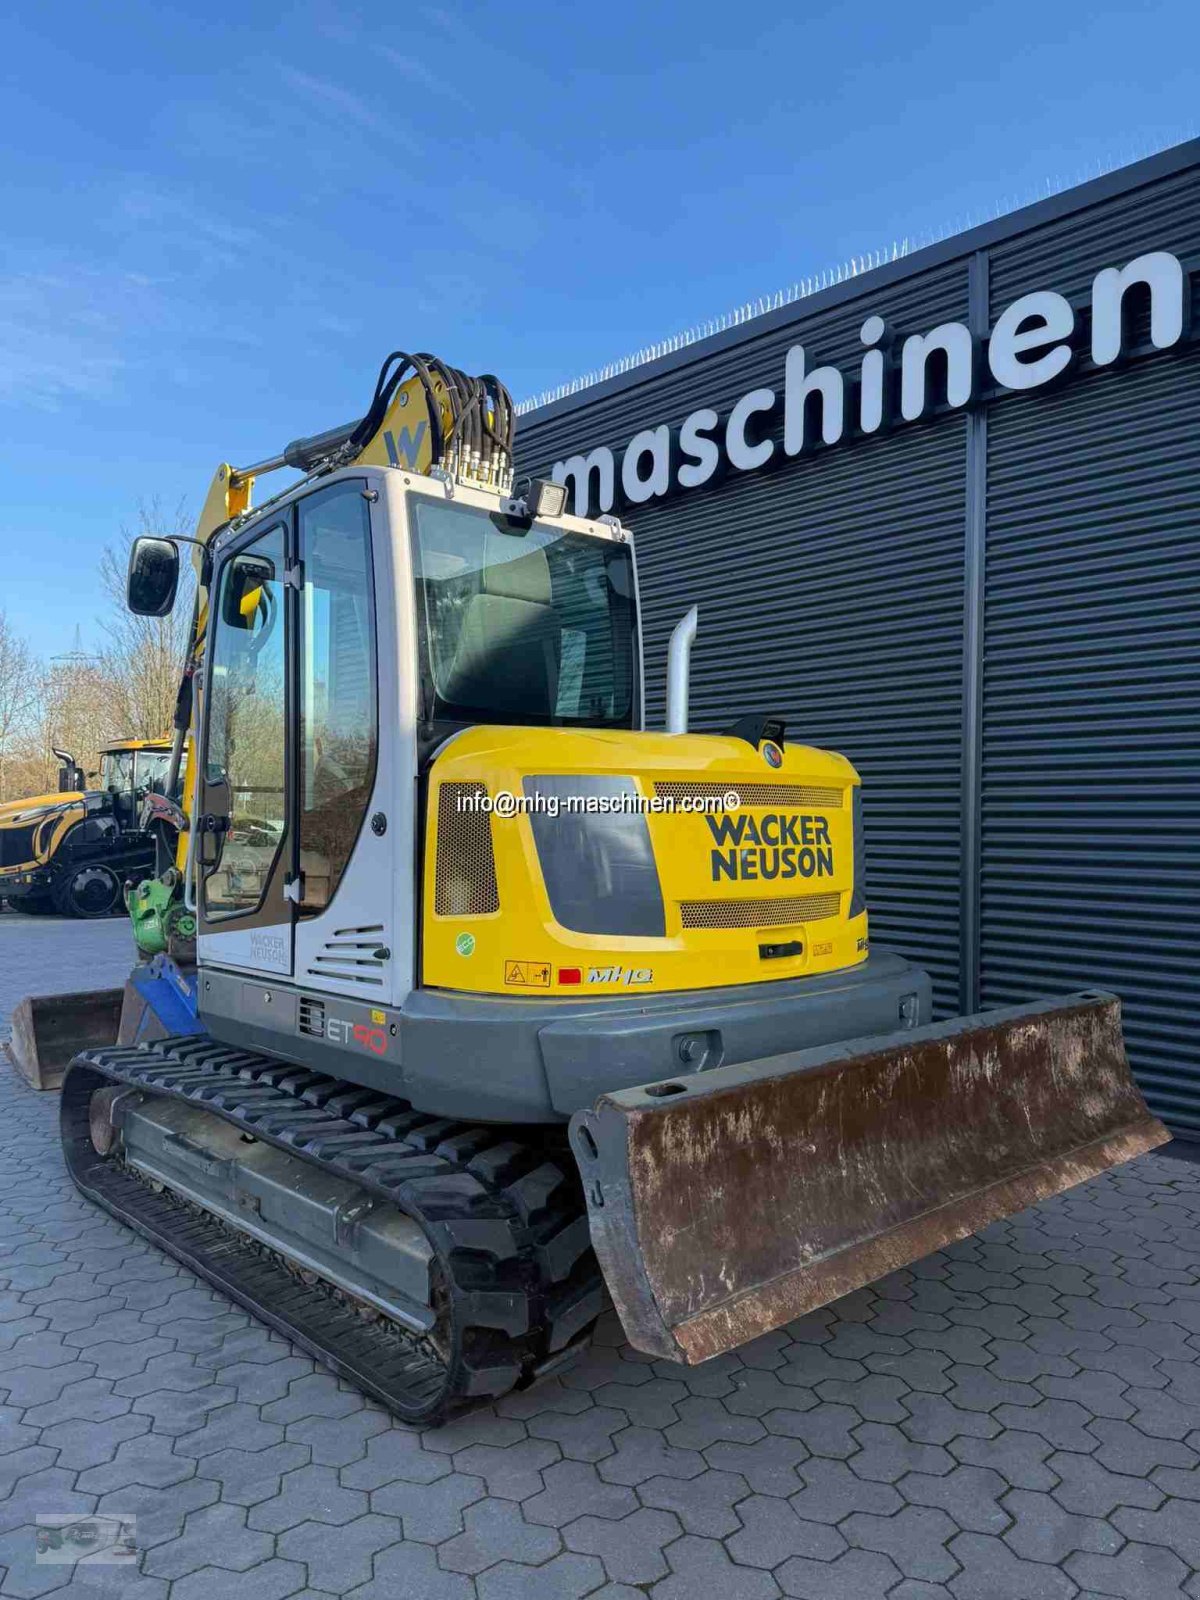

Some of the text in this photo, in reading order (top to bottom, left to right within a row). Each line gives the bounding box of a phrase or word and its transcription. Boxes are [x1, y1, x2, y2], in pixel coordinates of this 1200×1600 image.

[552, 252, 1183, 517] maschinen
[705, 814, 832, 846] WACKER
[711, 847, 834, 881] NEUSON
